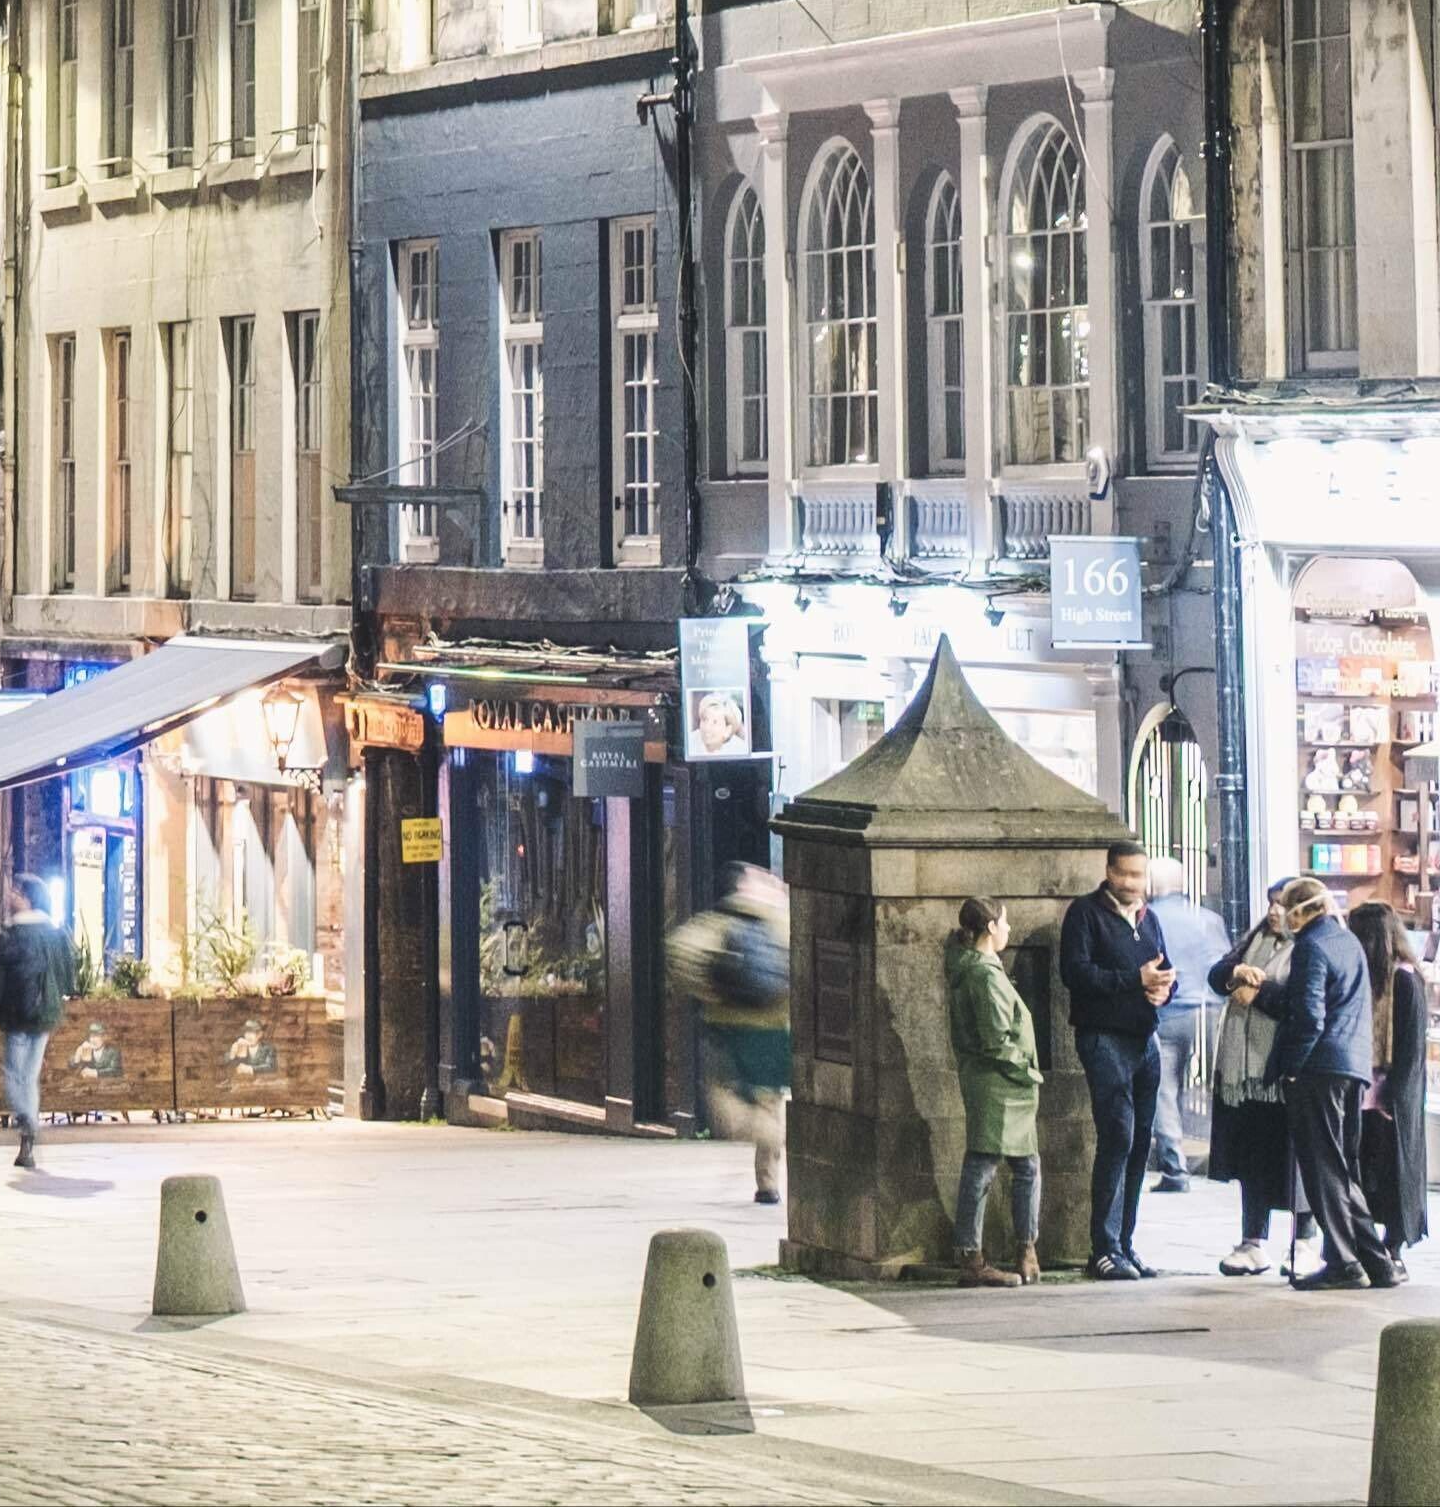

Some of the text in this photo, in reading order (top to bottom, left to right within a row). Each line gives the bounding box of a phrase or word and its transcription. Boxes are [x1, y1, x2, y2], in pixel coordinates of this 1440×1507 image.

[1062, 557, 1129, 597] 166
[1061, 607, 1132, 624] High Street
[469, 698, 522, 732] ROYAL
[580, 757, 638, 768] CASHMERE
[592, 751, 625, 761] ROYAL
